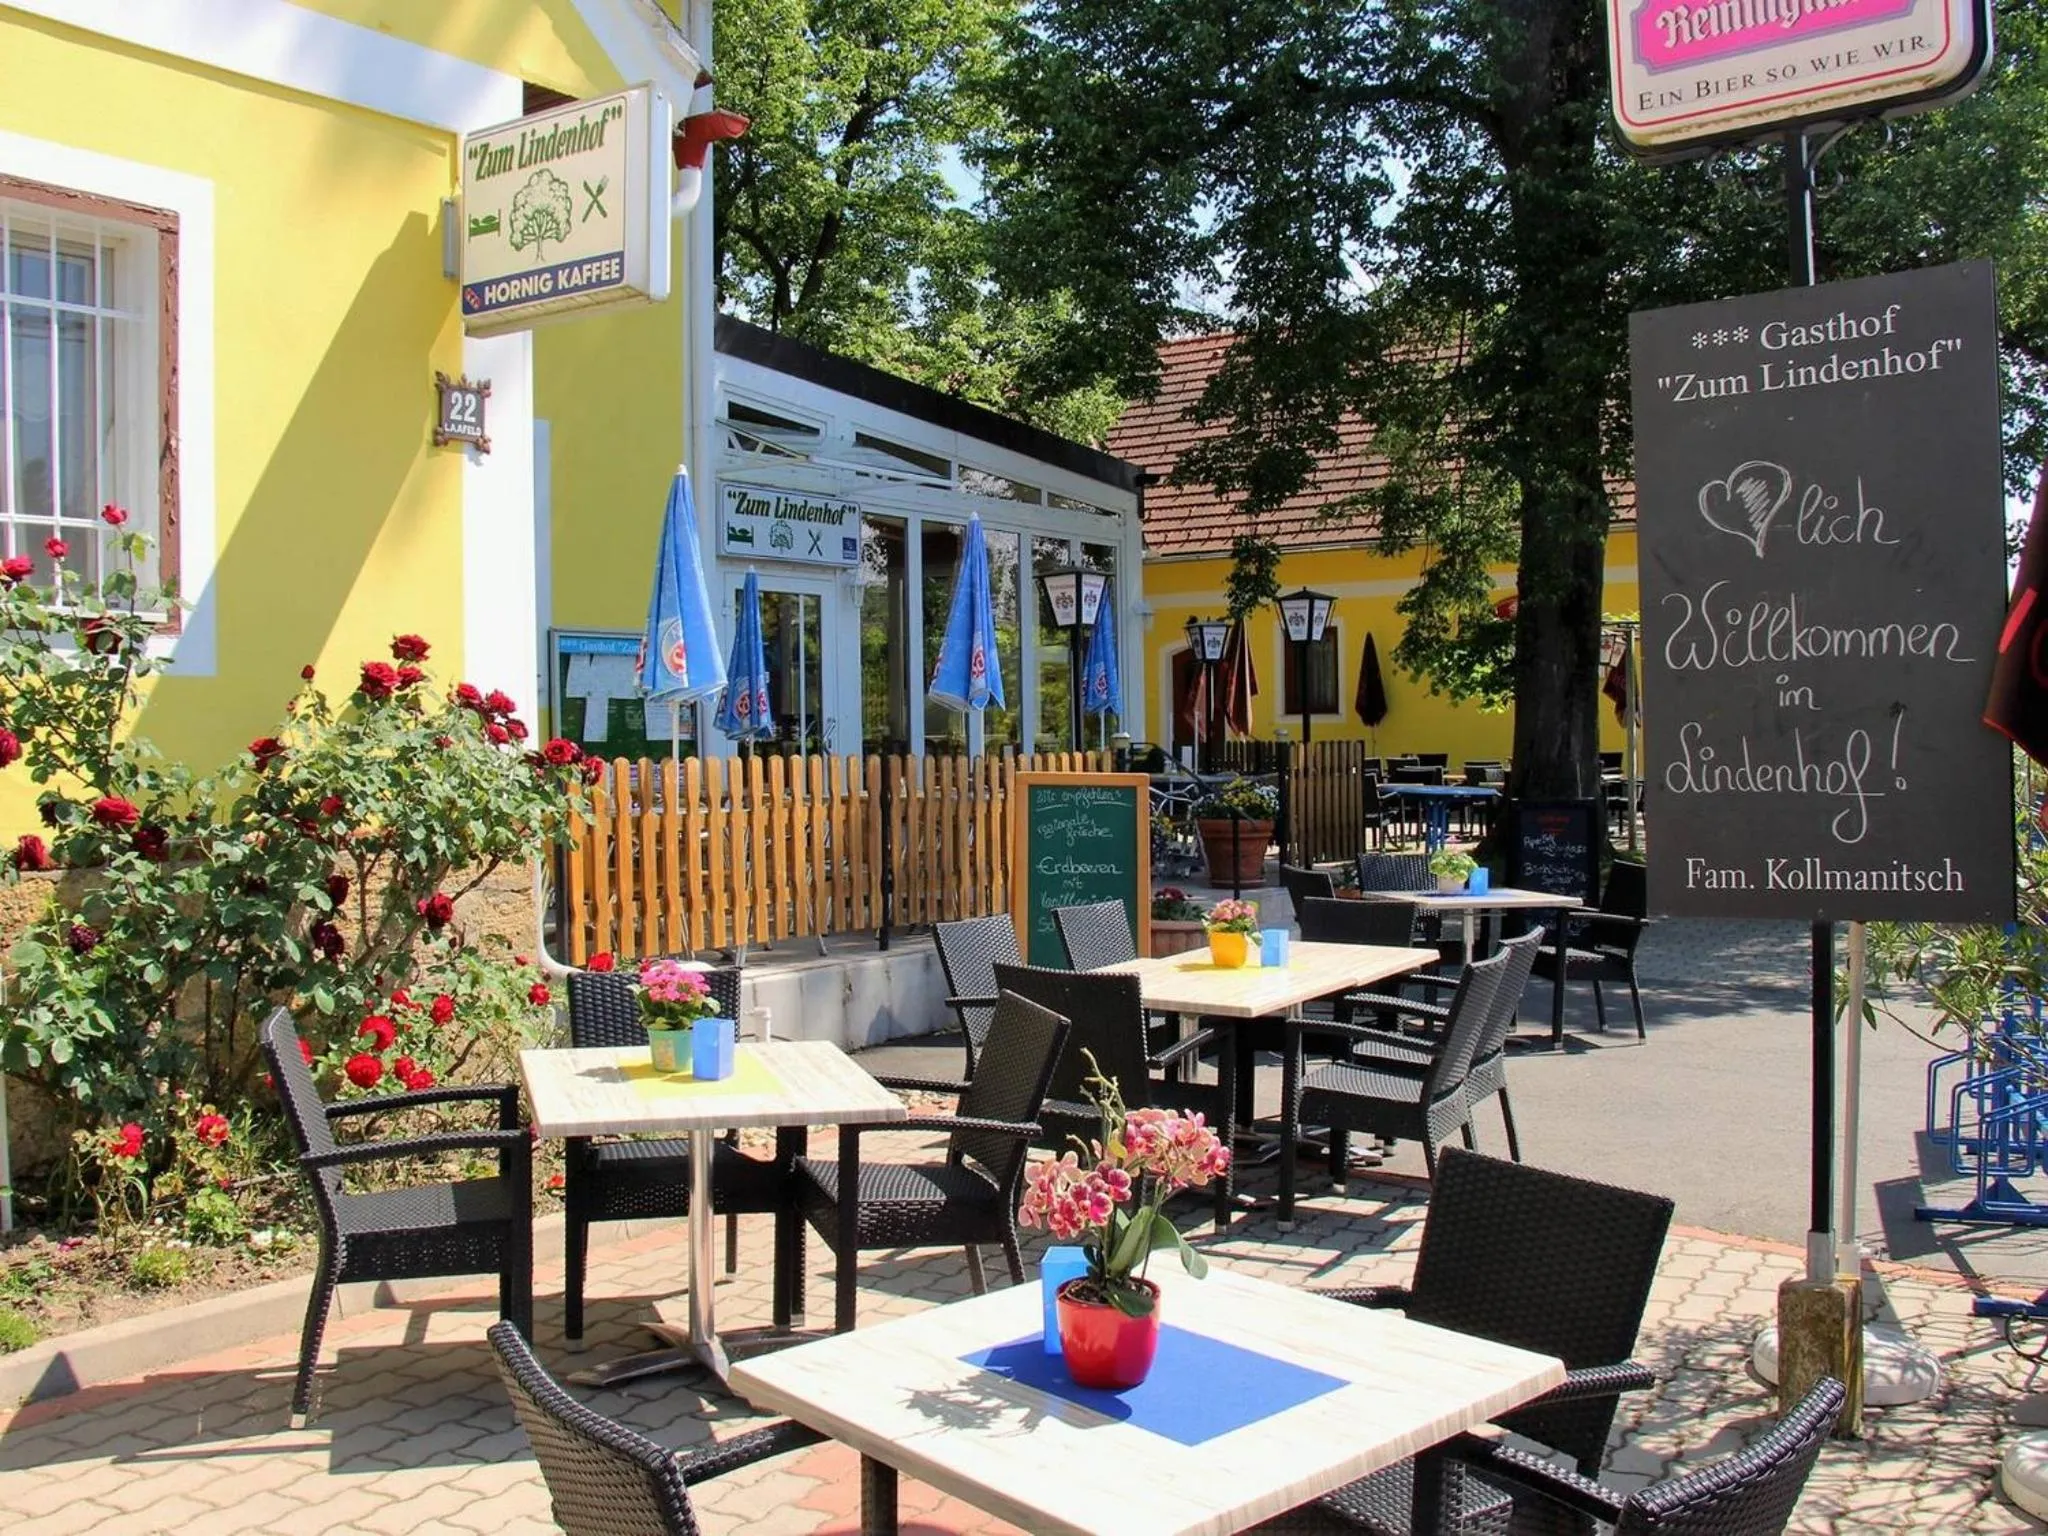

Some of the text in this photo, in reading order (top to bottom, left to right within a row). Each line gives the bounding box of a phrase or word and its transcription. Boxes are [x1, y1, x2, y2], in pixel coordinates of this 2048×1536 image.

[1638, 89, 1683, 111] EIN
[1696, 74, 1755, 99] BIER
[1766, 64, 1797, 81] SO
[1811, 49, 1860, 73] WIE
[484, 257, 621, 304] HORNIG KAFFEE
[1760, 303, 1901, 350] Gasthof
[444, 421, 482, 436] LAAFELD
[450, 391, 477, 423] 22
[1661, 579, 1976, 670] Willkommen
[1686, 858, 1965, 892] Fam. Kollmanitsch
